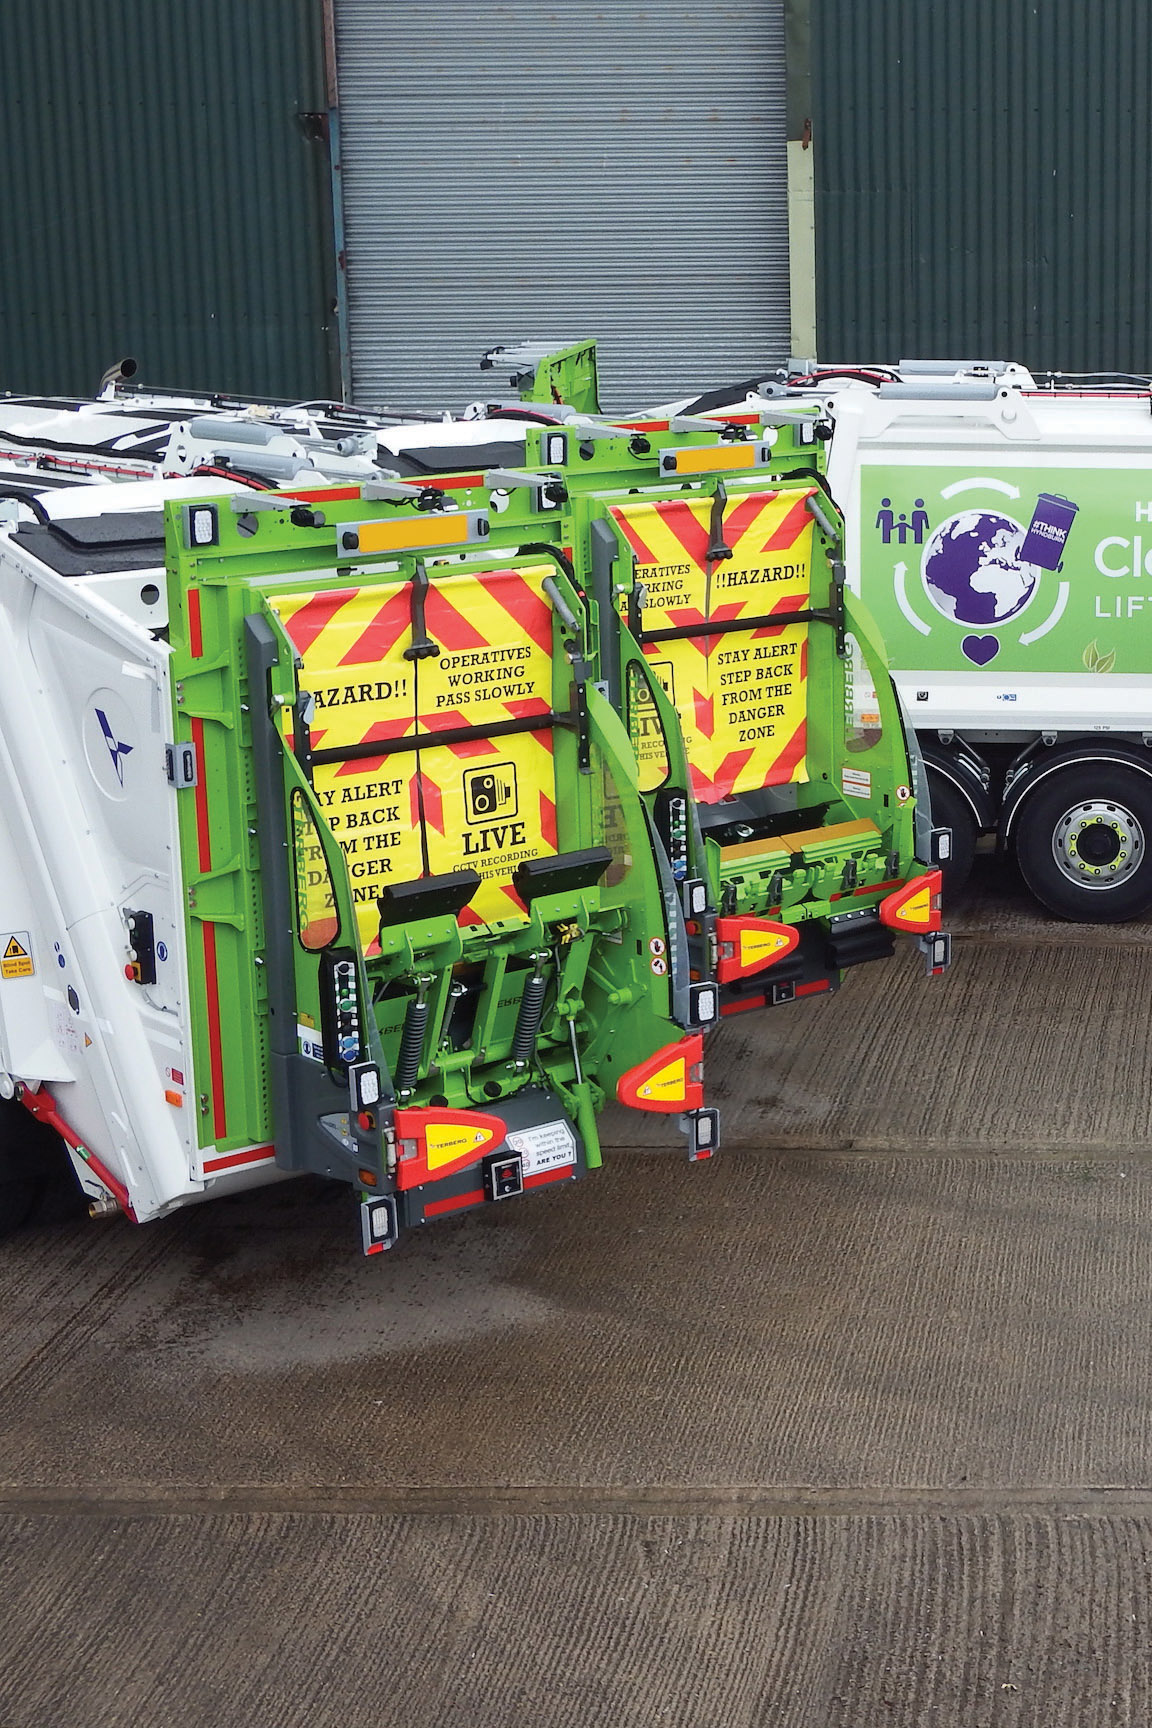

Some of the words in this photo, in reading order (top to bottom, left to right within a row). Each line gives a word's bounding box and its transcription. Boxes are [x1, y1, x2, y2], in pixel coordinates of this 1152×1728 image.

[1032, 520, 1068, 539] #THINK
[635, 565, 691, 579] ERATIVES
[715, 564, 806, 589] !!HAZARD!!
[645, 580, 683, 593] RKING
[439, 646, 532, 671] OPERATIVES
[717, 648, 751, 665] STAY
[752, 643, 798, 660] ALERT
[448, 665, 525, 688] WORKING
[720, 669, 753, 686] STEP
[755, 664, 793, 680] BACK
[313, 679, 407, 709] AZARD!!
[436, 688, 470, 707] PASS
[473, 681, 536, 703] SLOWLY
[722, 688, 763, 706] FROM
[765, 683, 793, 701] THE
[728, 704, 785, 724] DANGER
[738, 725, 775, 742] ZONE
[341, 780, 403, 804] ALERT
[346, 806, 401, 829] BACK
[362, 831, 401, 850] THE
[462, 822, 526, 856] LIVE
[453, 860, 479, 873] CCTV
[480, 849, 538, 867] RECORDING
[480, 870, 494, 880] HIS
[436, 1138, 468, 1149] TERBERG
[552, 1153, 567, 1161] YOU
